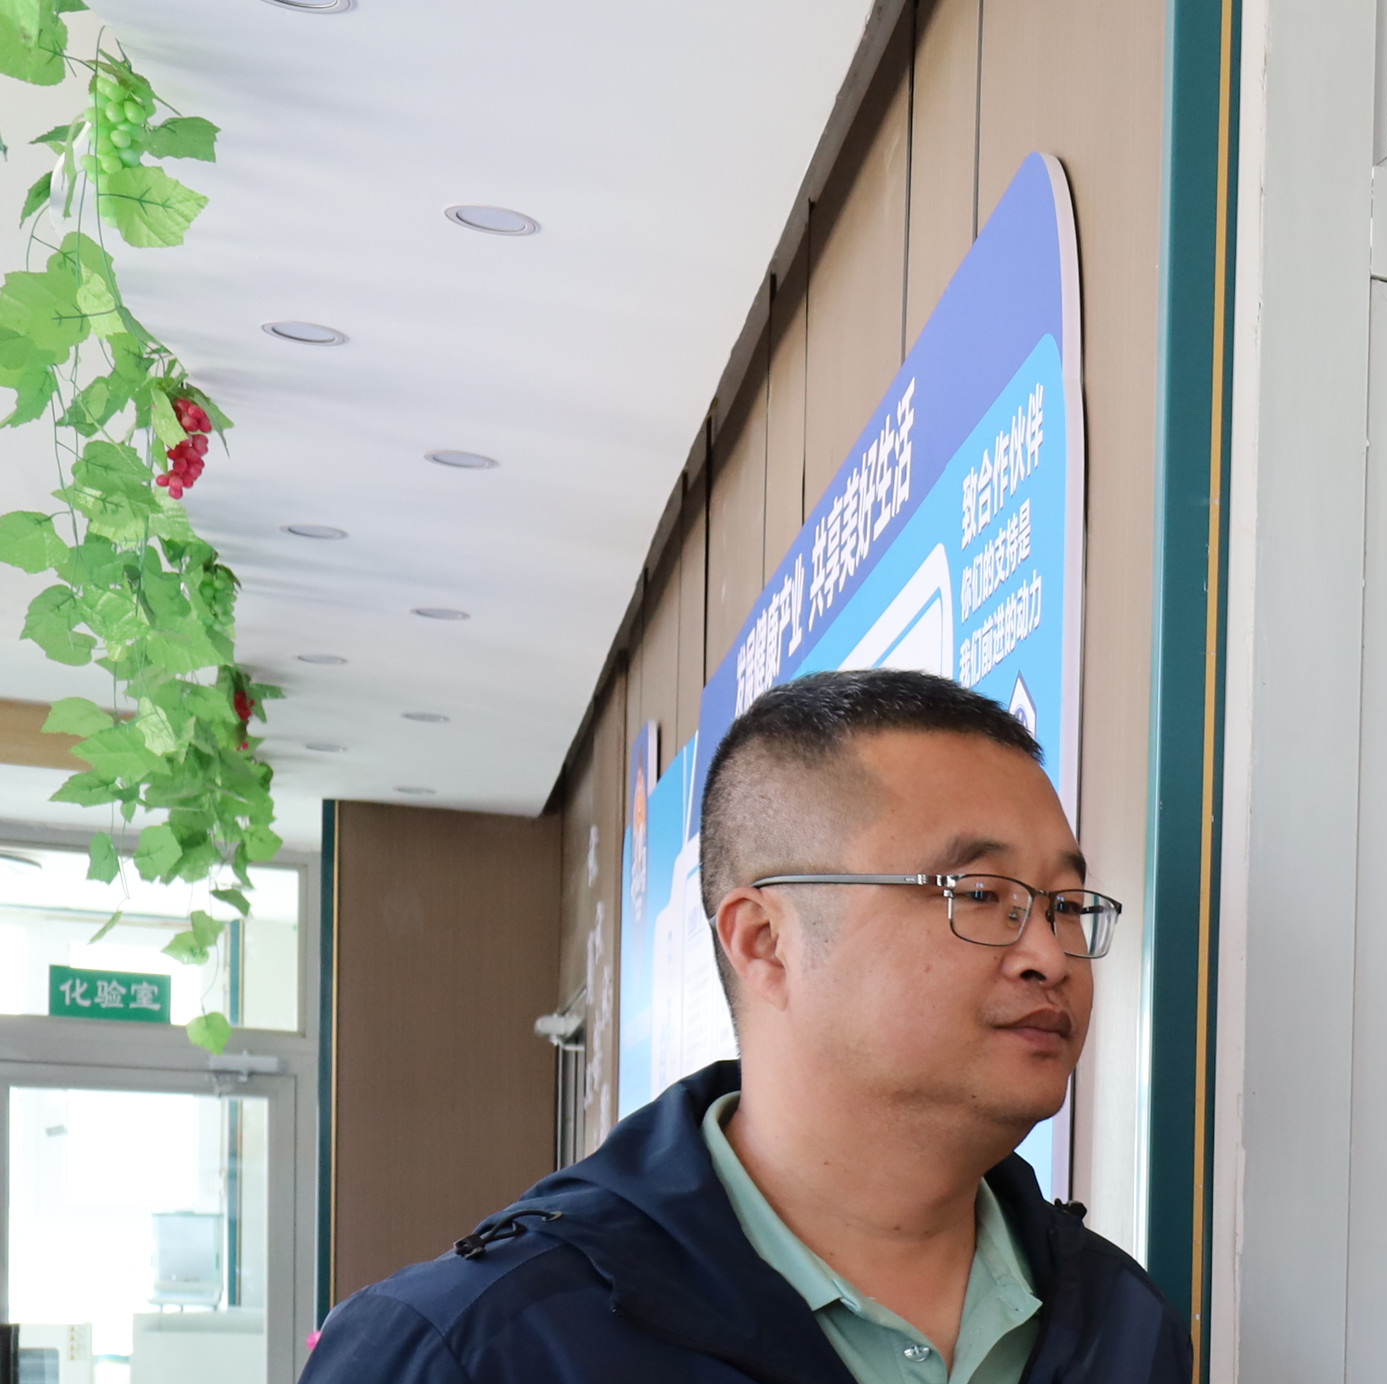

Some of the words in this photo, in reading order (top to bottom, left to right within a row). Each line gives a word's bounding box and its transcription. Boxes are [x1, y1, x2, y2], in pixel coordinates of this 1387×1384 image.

[809, 377, 915, 632] 共享美好生活
[962, 383, 1044, 550] 致合作伙伴
[961, 498, 1031, 623] 你们的支持是
[959, 568, 1043, 688] 我们前进的动力
[59, 978, 162, 1011] 化验室
